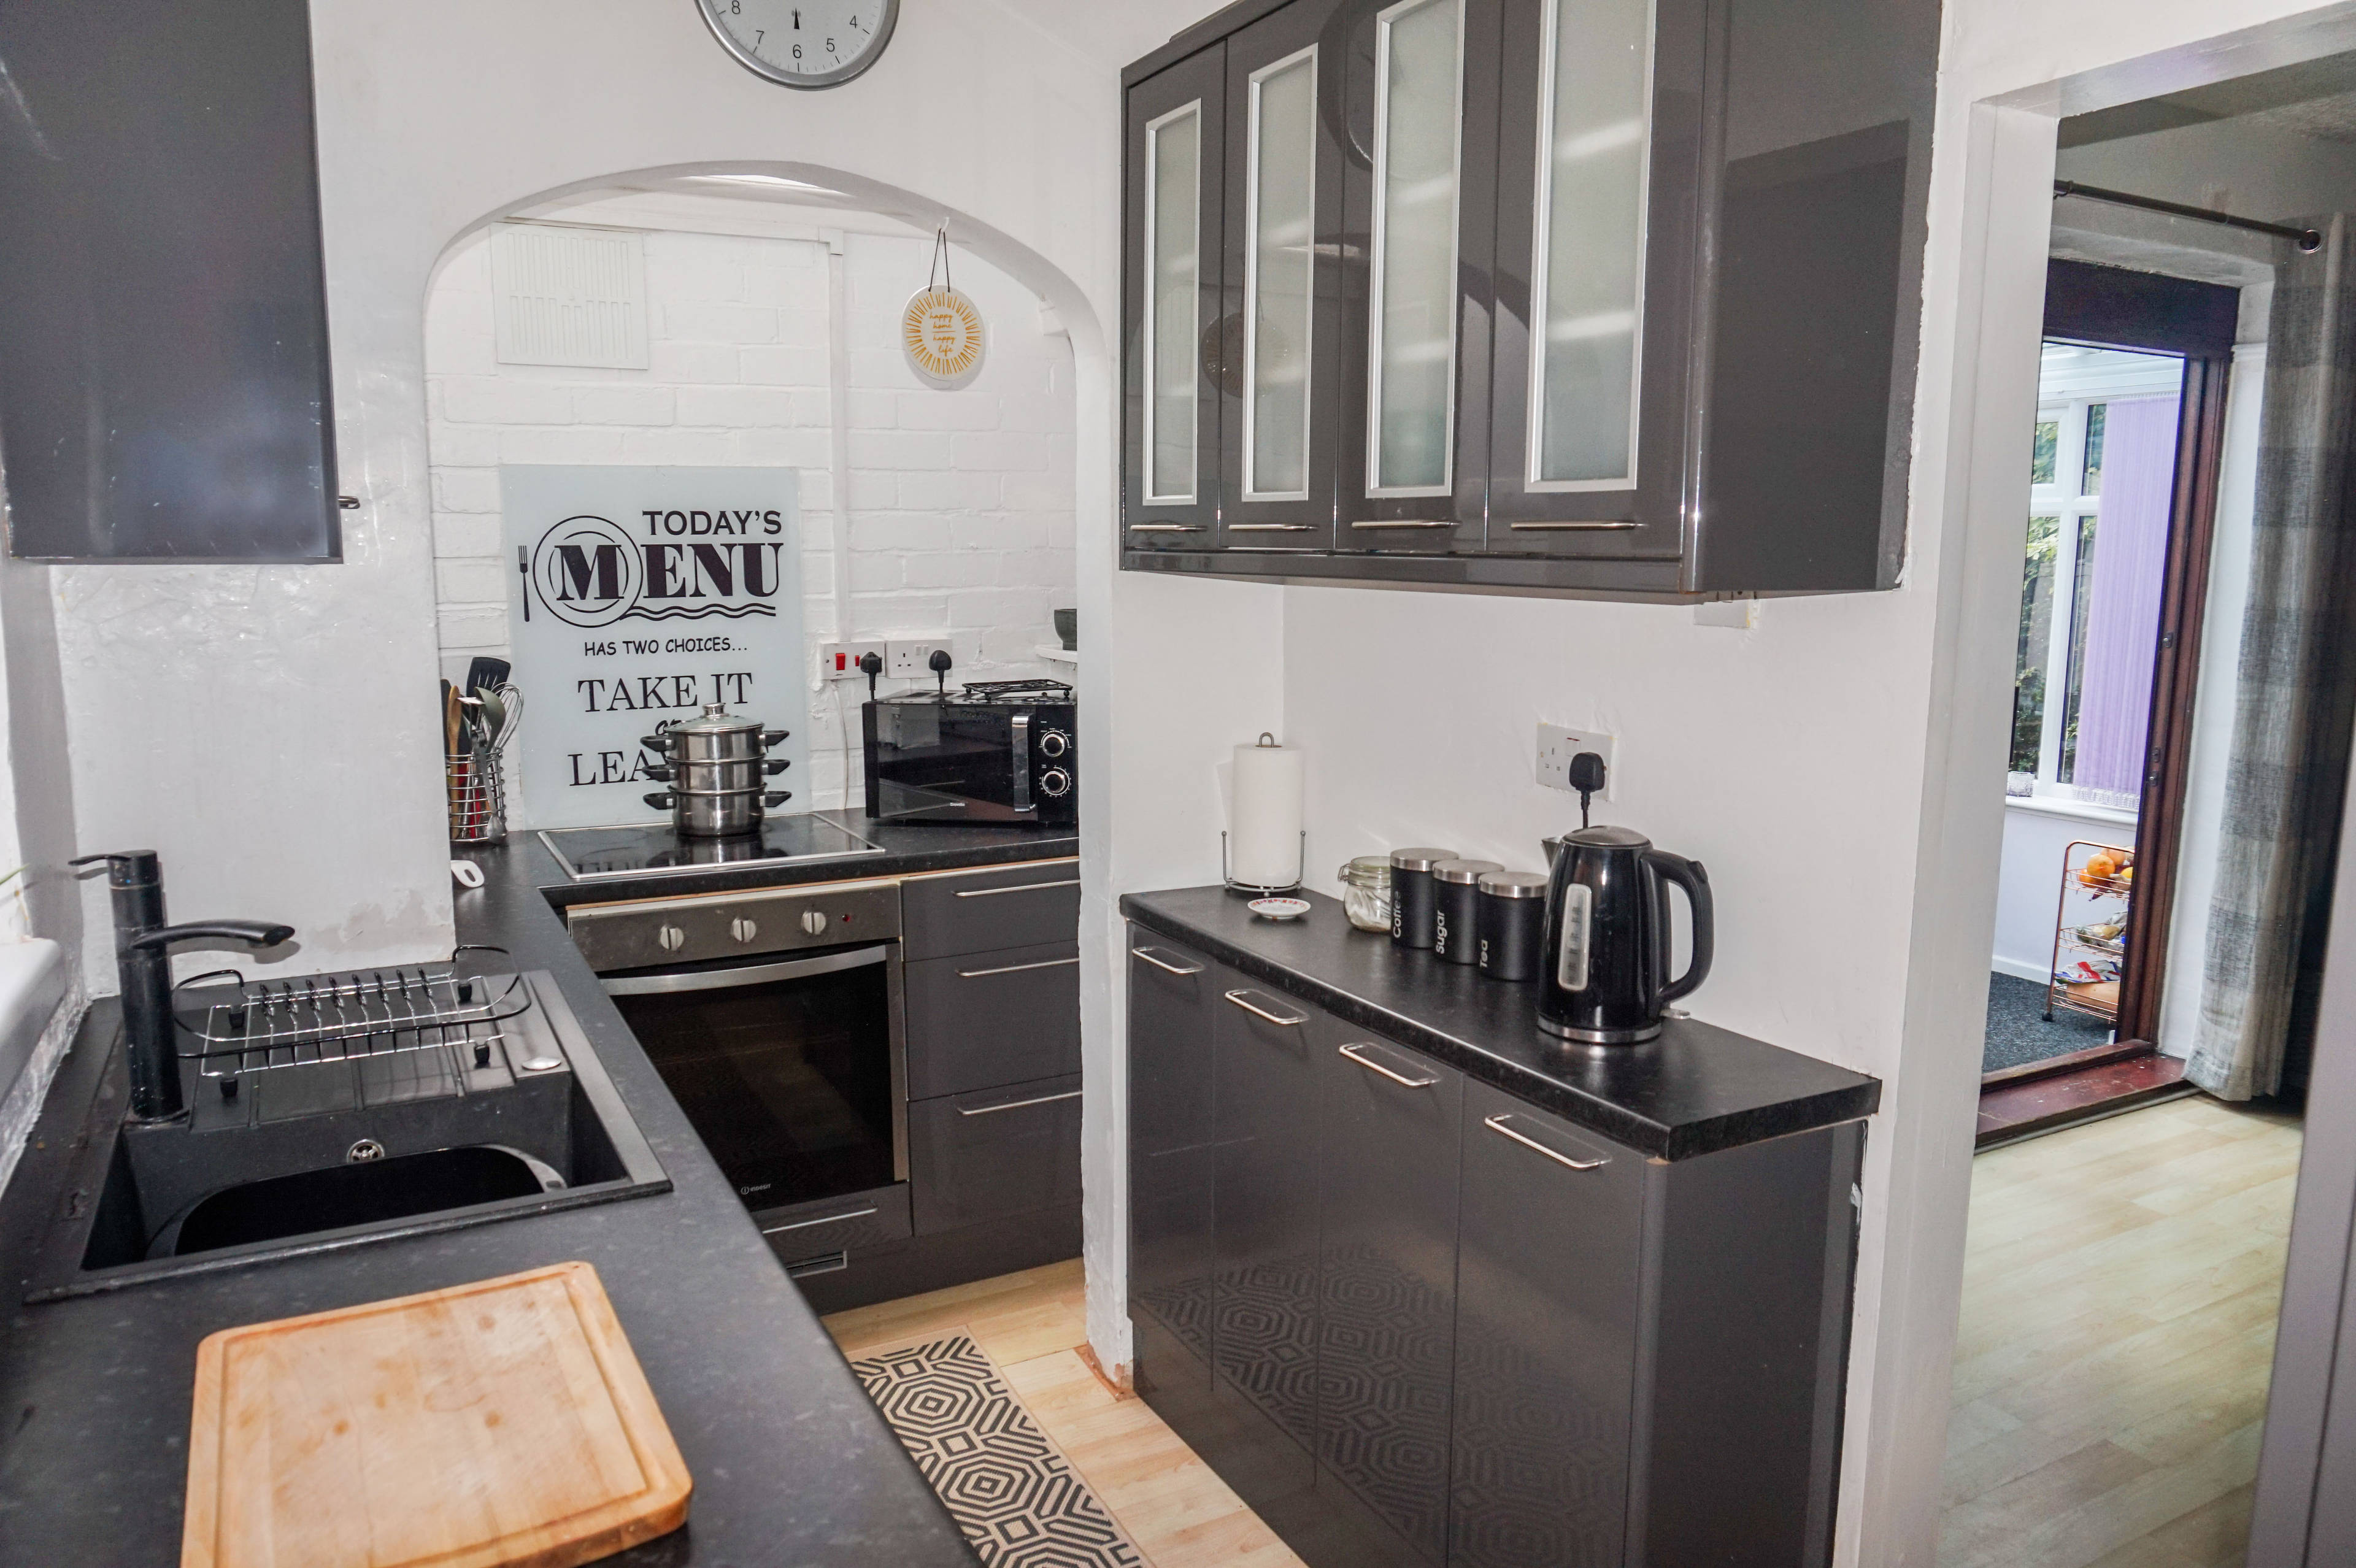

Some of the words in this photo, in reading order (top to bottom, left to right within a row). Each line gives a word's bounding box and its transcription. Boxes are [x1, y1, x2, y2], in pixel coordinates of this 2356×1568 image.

[731, 0, 741, 15] 8
[849, 15, 858, 29] 4
[755, 29, 765, 44] 7
[826, 38, 835, 52] 5
[792, 44, 802, 59] 6
[930, 312, 953, 323] happy
[933, 334, 956, 344] happy
[938, 344, 953, 357] life
[642, 509, 782, 536] TODAY'S
[555, 542, 784, 601] MENU
[584, 642, 617, 656] HAS
[622, 639, 659, 655] TWO
[665, 636, 748, 653] CHOICES...
[577, 674, 698, 712] TAKE
[710, 672, 753, 705] IT
[567, 748, 669, 786] LEA
[1393, 891, 1402, 939] Coffee
[1436, 910, 1448, 955] Sugar
[1479, 939, 1488, 968] Tea
